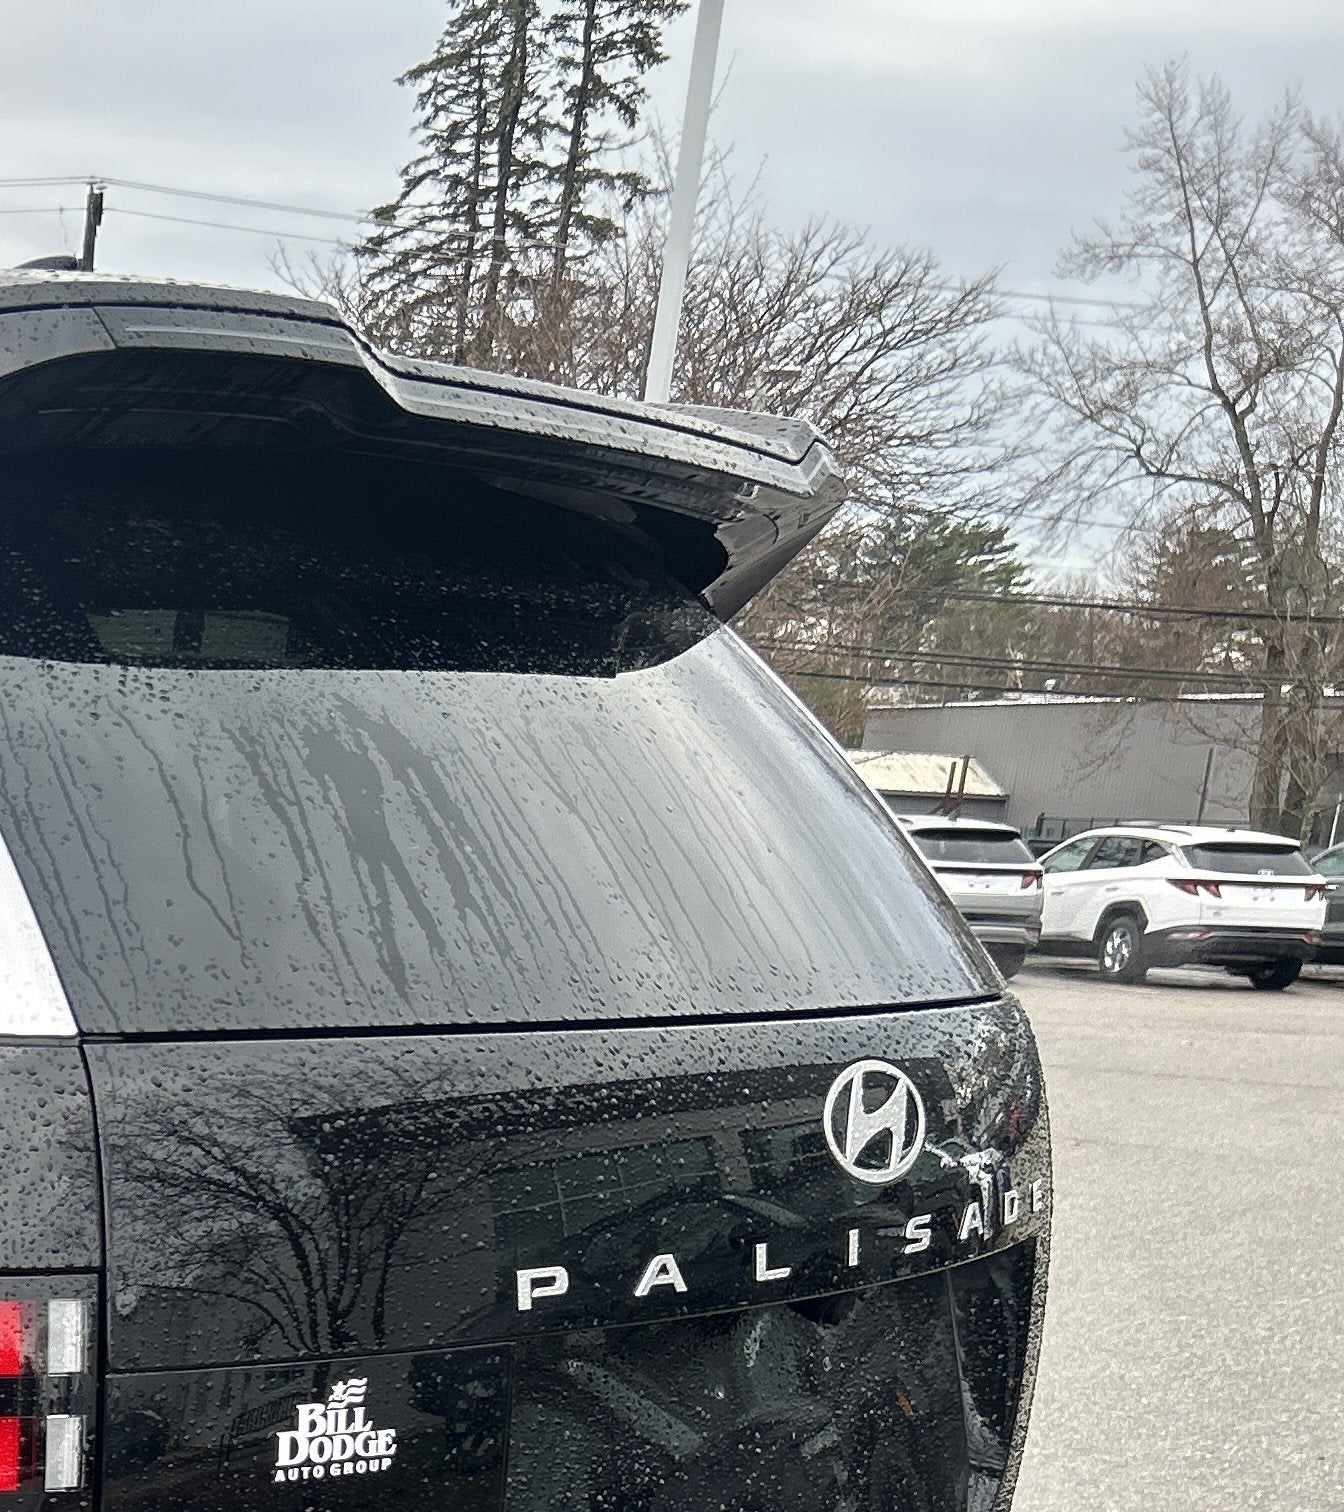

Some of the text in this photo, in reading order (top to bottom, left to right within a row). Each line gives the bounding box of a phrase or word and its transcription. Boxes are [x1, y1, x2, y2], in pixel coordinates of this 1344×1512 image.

[517, 1177, 1044, 1311] PALISADE
[296, 1402, 373, 1438] BILL
[275, 1428, 397, 1467] DODGE
[274, 1457, 392, 1482] AUTO GROUP
